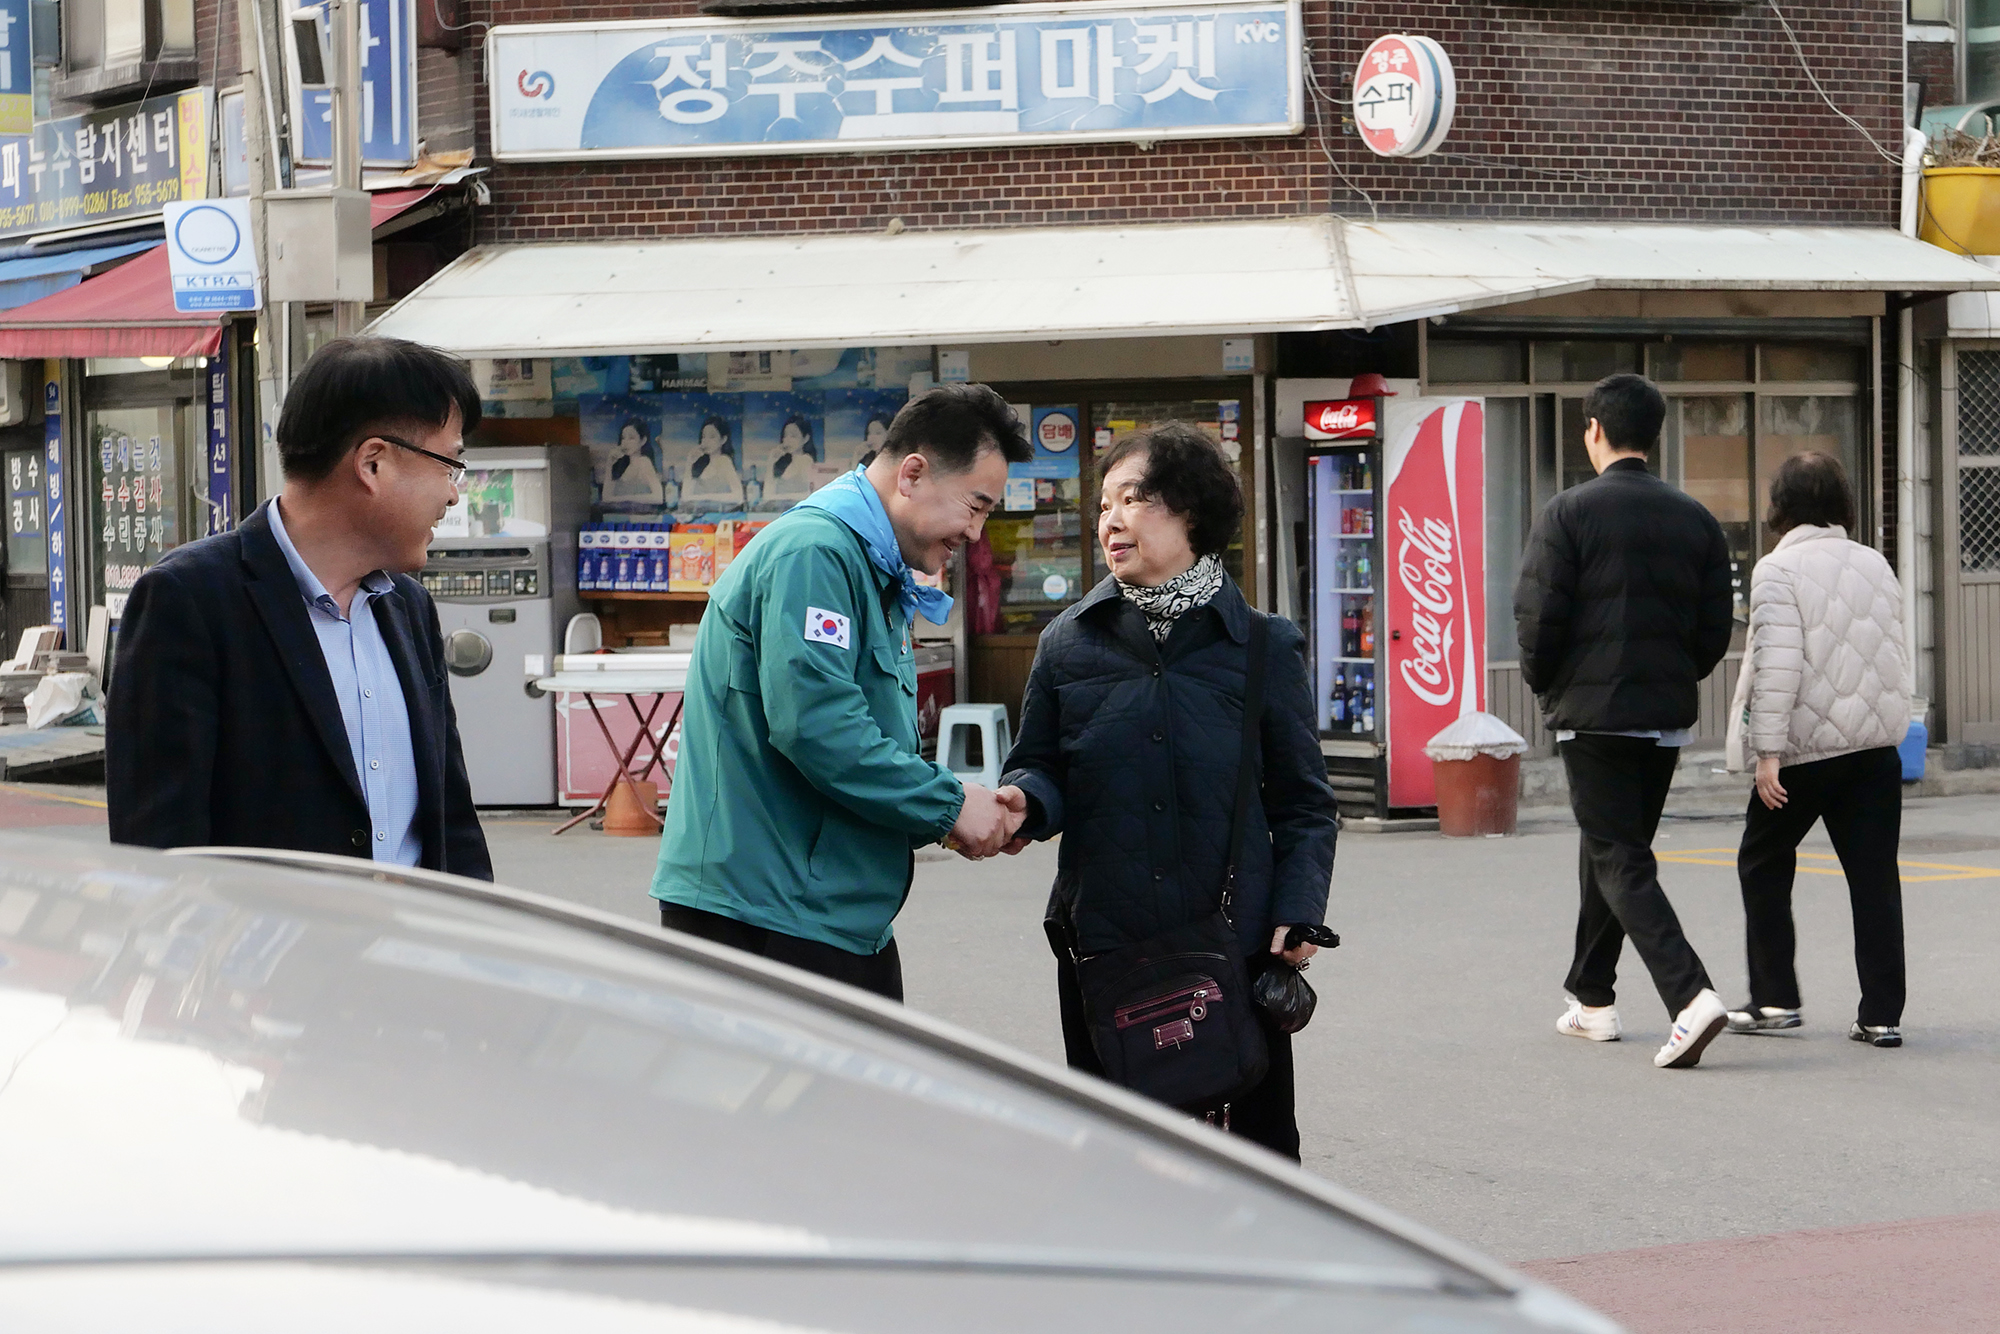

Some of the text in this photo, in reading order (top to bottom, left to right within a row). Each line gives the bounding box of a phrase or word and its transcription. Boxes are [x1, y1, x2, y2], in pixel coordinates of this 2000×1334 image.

[1234, 22, 1279, 44] KVC
[652, 14, 1220, 125] 정주수퍼마켓
[1371, 48, 1409, 73] 정주
[1358, 82, 1414, 118] 수퍼
[1399, 505, 1455, 706] Coca-Cola
